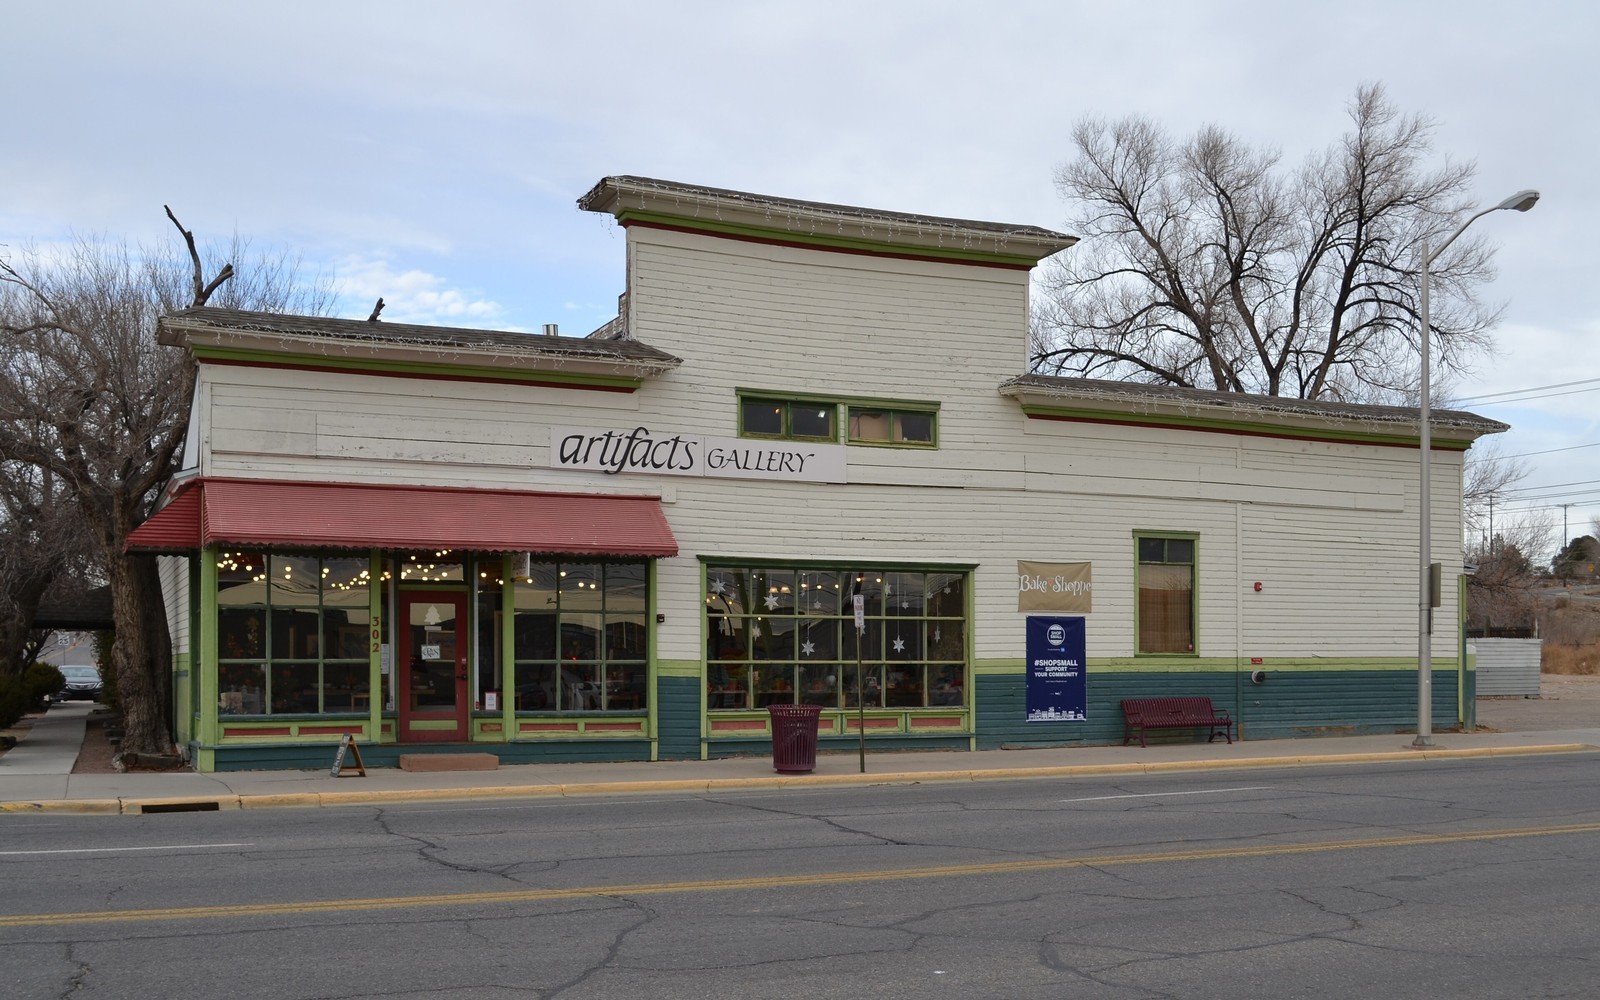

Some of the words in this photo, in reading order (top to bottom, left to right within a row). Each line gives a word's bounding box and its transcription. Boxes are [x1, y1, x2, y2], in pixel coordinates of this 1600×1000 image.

[559, 426, 698, 475] artifacts
[707, 448, 815, 473] GALLERY
[1018, 574, 1048, 593] Bake
[372, 616, 380, 653] 302
